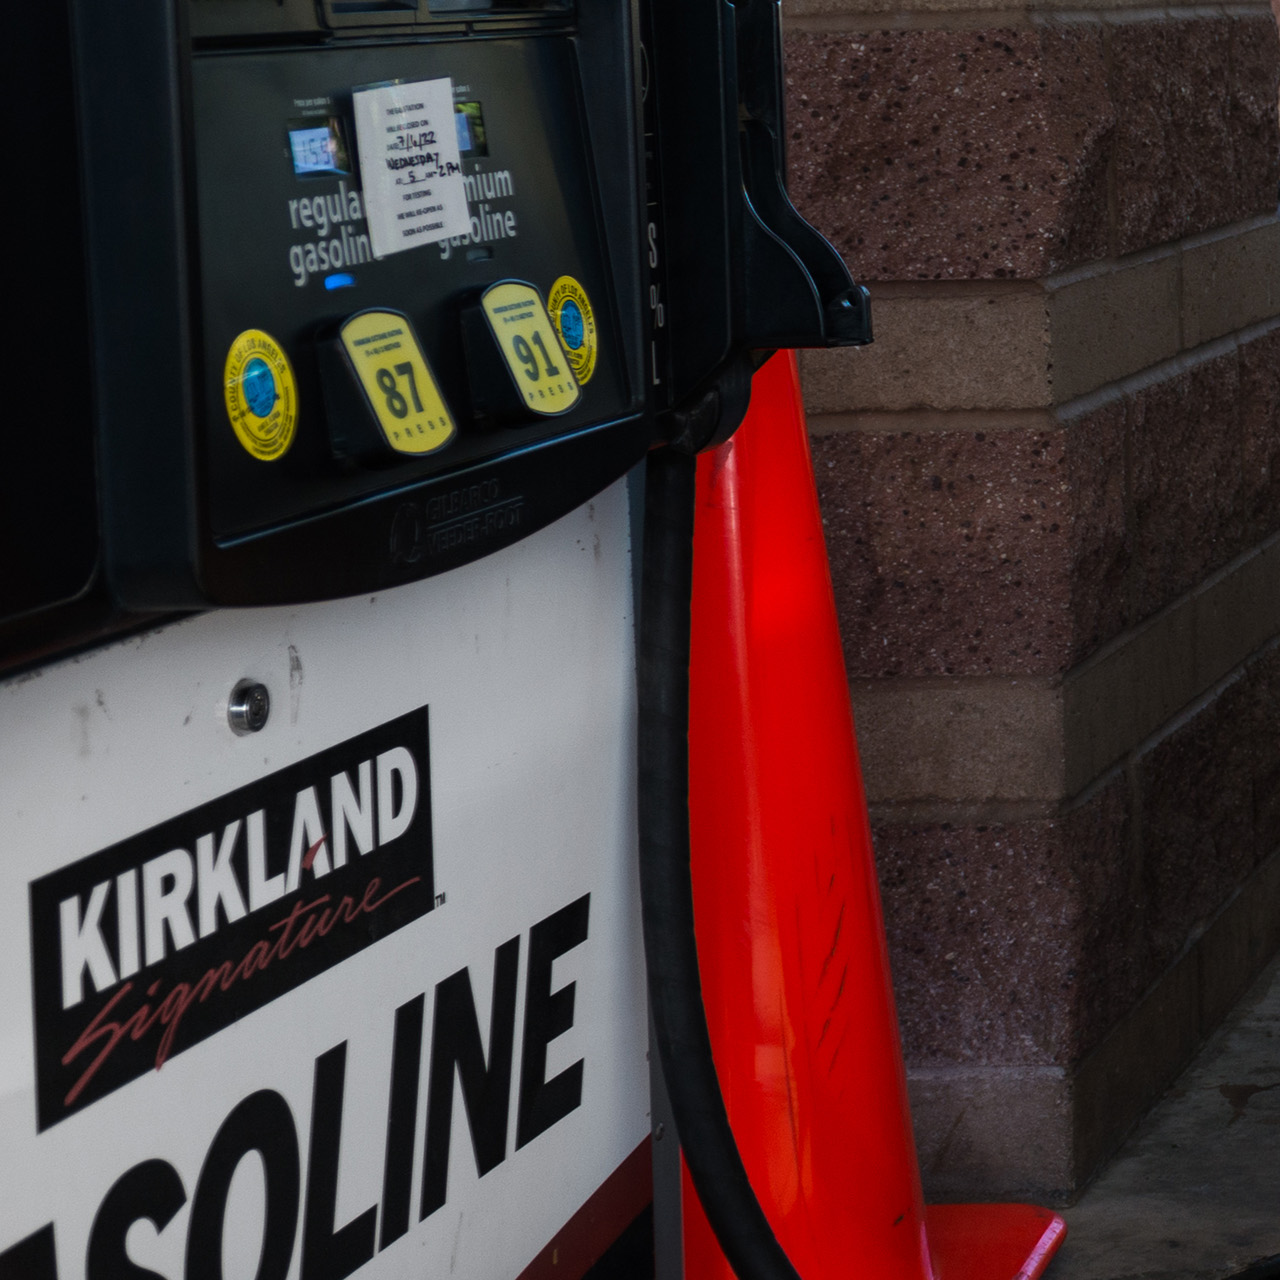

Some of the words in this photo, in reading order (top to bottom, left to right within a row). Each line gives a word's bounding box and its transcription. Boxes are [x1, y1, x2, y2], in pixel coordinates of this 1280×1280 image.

[385, 152, 440, 171] WEDNESDAY
[462, 164, 514, 203] mium
[288, 181, 364, 237] regula
[289, 225, 384, 287] gasolin
[511, 330, 560, 382] 91
[375, 360, 425, 419] 87
[528, 381, 574, 402] PRESS
[393, 416, 447, 442] PRESS
[425, 477, 500, 521] GILBARCO
[59, 746, 418, 1010] KIRKLAND
[61, 876, 422, 1107] Signature
[0, 892, 591, 1280] SOLINE
